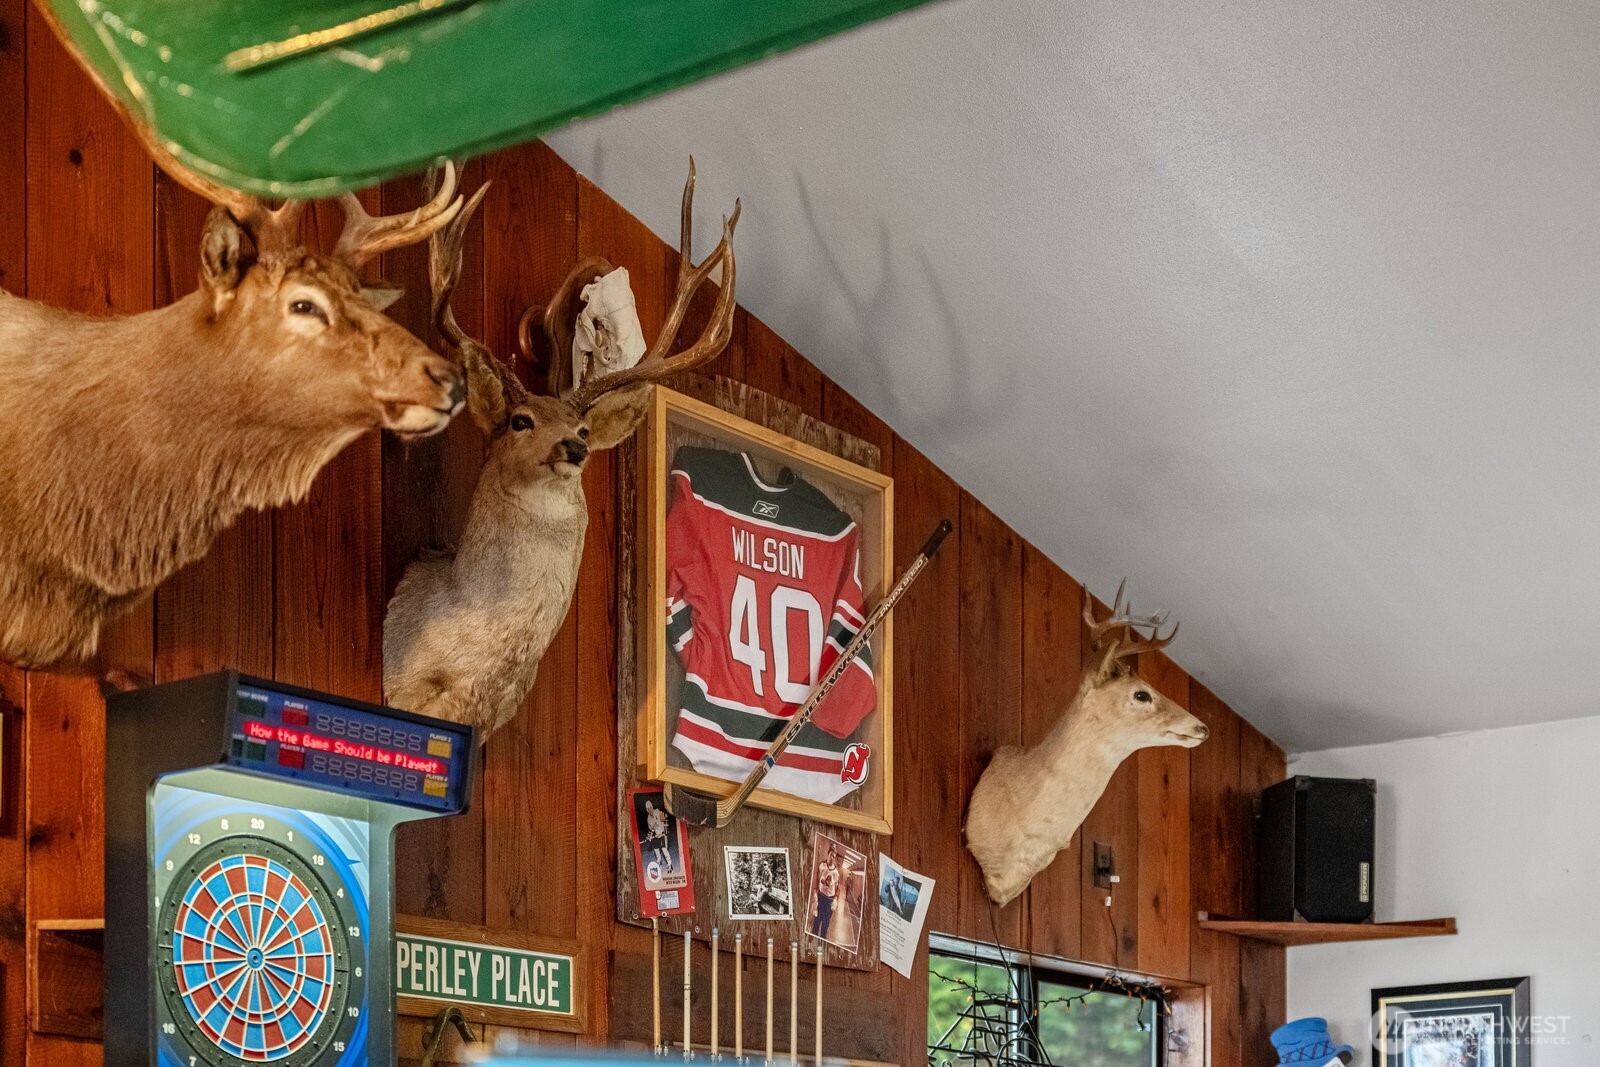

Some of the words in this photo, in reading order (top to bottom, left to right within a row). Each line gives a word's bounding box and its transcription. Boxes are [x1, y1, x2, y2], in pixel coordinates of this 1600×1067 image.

[731, 526, 805, 580] WILSON
[729, 574, 825, 705] 40
[250, 723, 272, 739] How
[277, 728, 298, 745] the
[302, 734, 330, 751] Game
[334, 741, 373, 760] Should
[377, 749, 391, 764] be
[220, 819, 229, 830] 5
[250, 818, 265, 830] 20
[188, 833, 201, 845] 12
[287, 831, 293, 842] 1
[312, 855, 325, 866] 18
[165, 861, 174, 872] 9
[336, 888, 345, 898] 4
[348, 926, 360, 937] 13
[355, 967, 362, 978] 6
[396, 940, 482, 998] PERLEY
[491, 954, 560, 1008] PLACE
[347, 1006, 359, 1018] 10
[162, 1023, 175, 1034] 16
[333, 1041, 345, 1052] 15
[189, 1056, 197, 1067] 7
